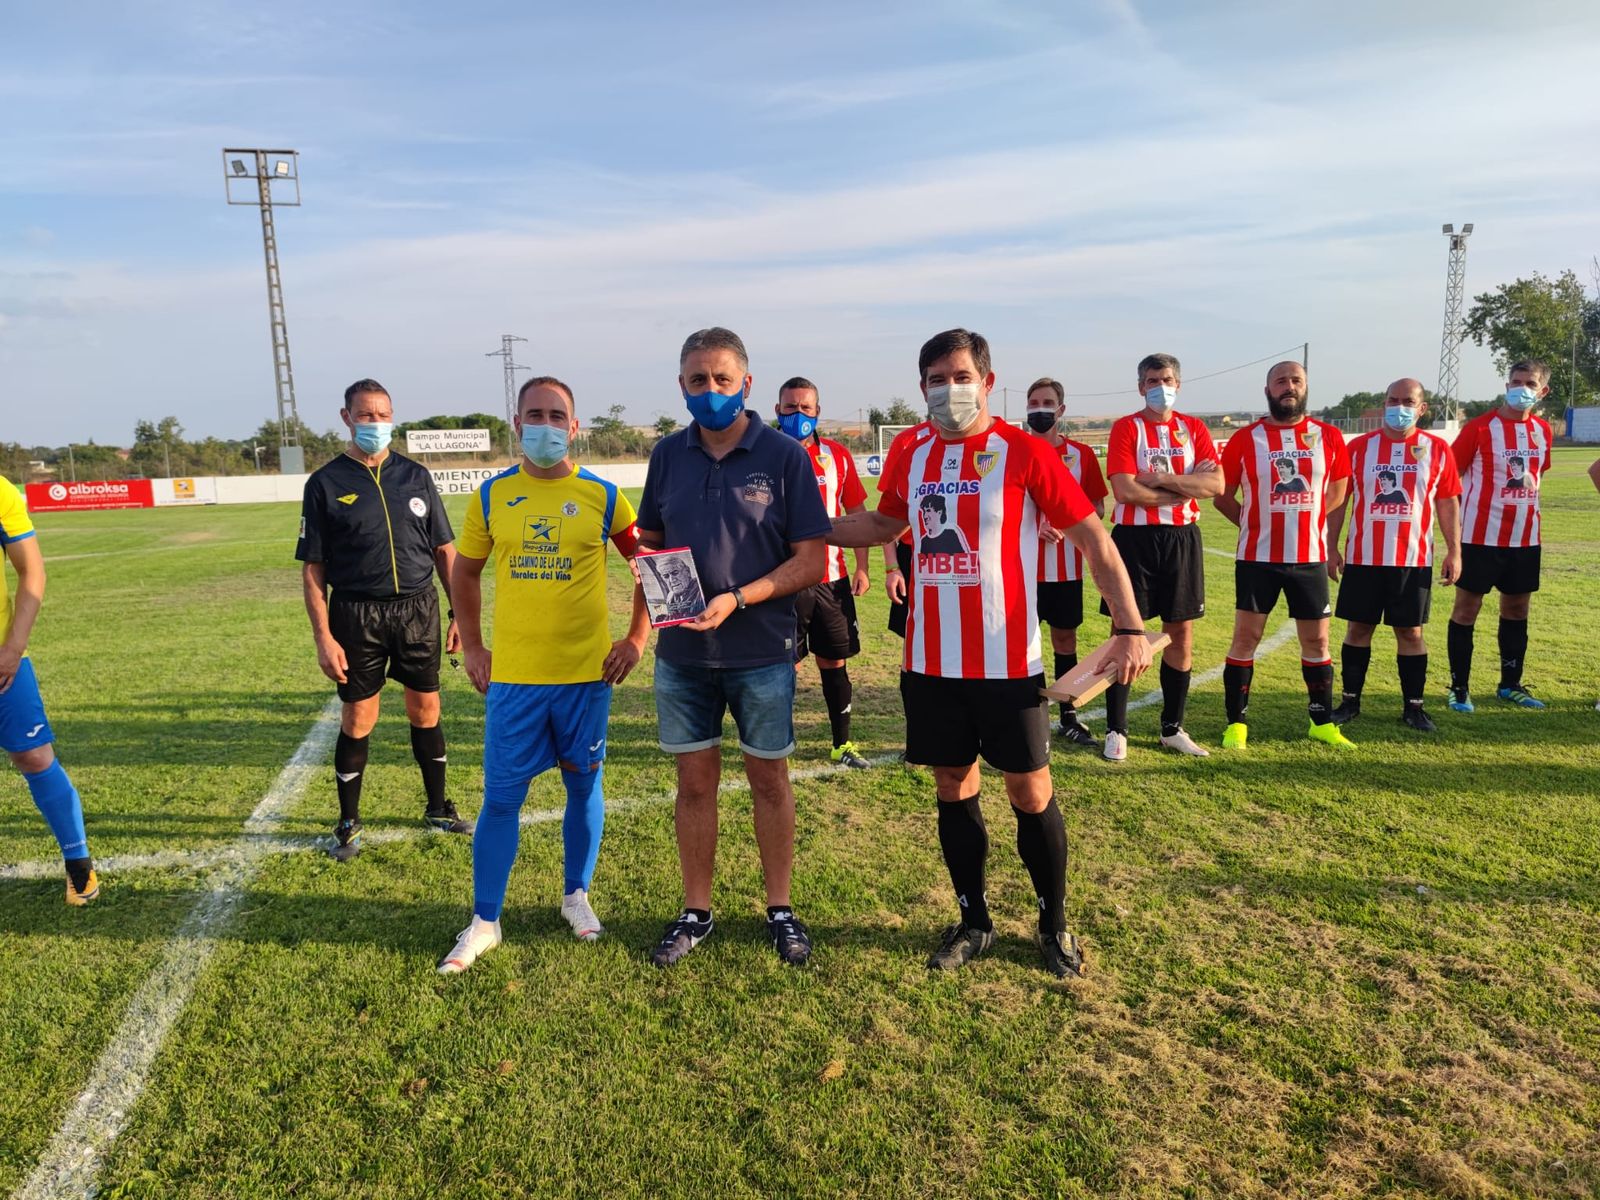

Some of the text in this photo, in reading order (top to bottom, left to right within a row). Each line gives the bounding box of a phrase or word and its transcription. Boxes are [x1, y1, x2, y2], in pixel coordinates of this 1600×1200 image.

[409, 431, 487, 441] Campo Municipal
[1268, 450, 1314, 460] ¡GRACIAS
[1372, 464, 1418, 473] ¡GRACIAS
[433, 470, 492, 481] MIENTO
[68, 483, 129, 496] albroksa
[914, 481, 980, 499] ¡GRACIAS
[1270, 491, 1315, 505] PIBE!
[1370, 503, 1413, 515] PIBE!
[540, 556, 547, 569] DE
[548, 556, 555, 569] LA
[556, 557, 572, 570] PLATA
[918, 552, 977, 574] PIBE!
[511, 569, 571, 581] Morales del Vino
